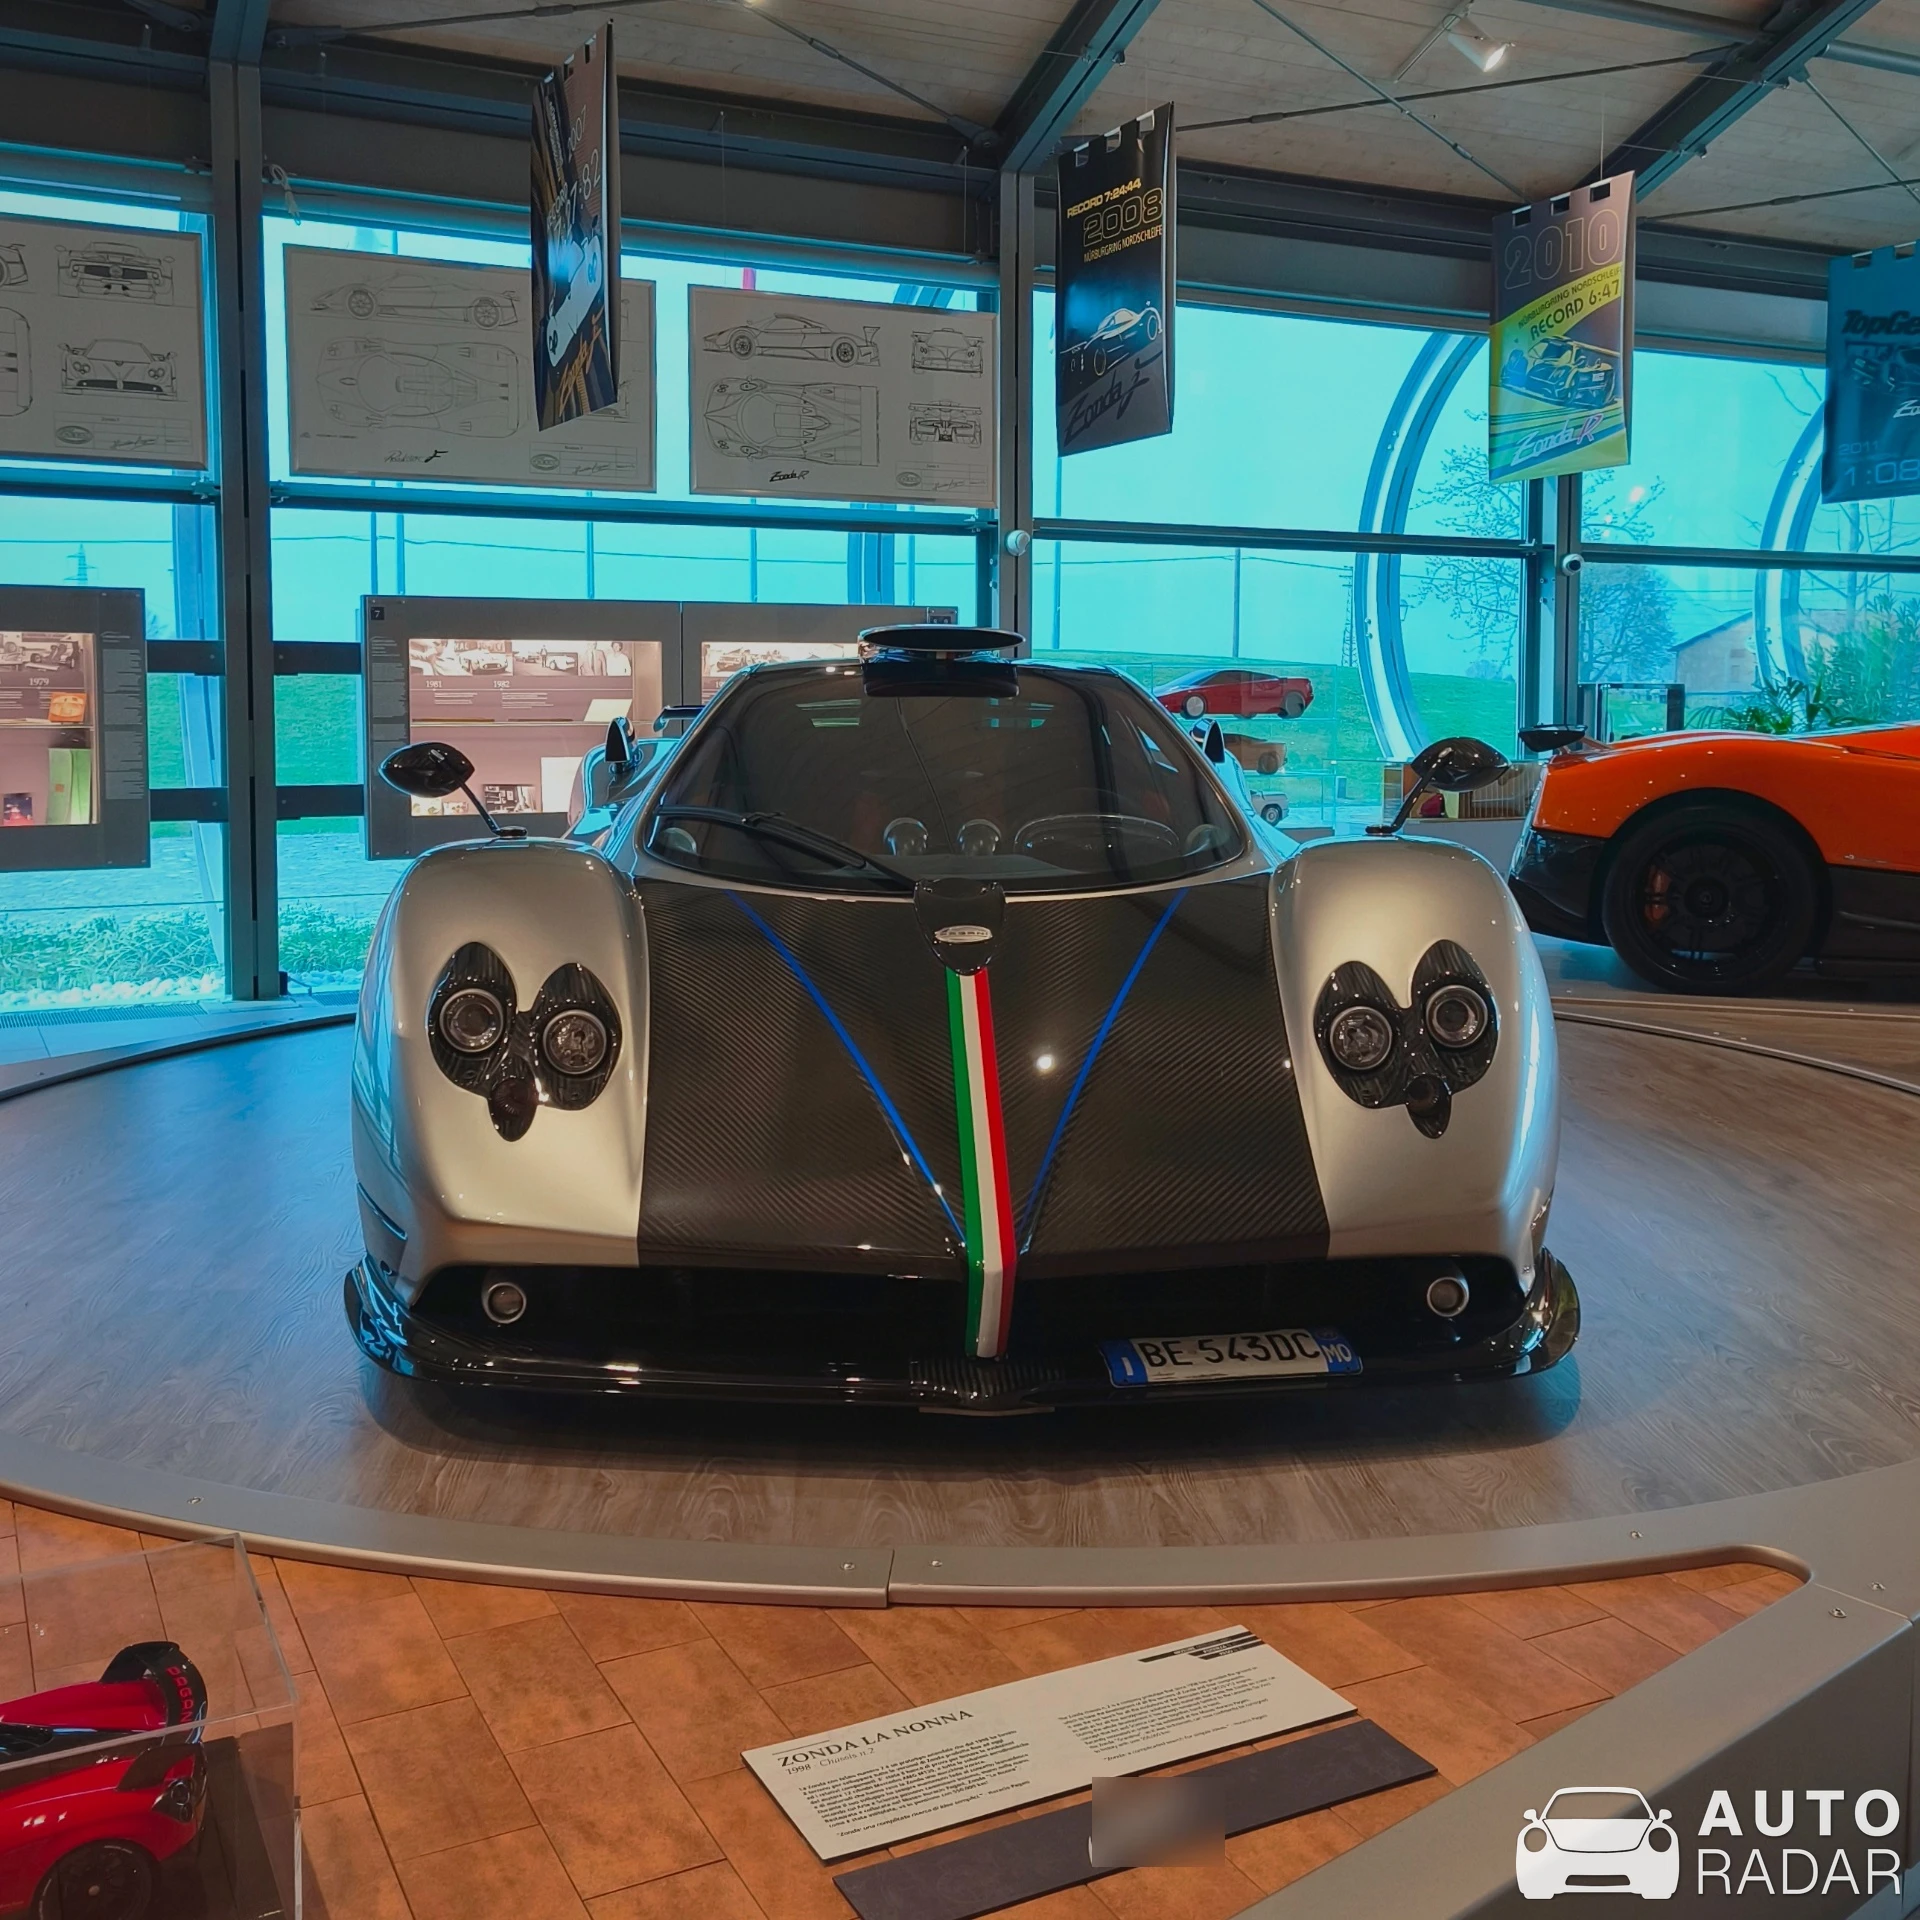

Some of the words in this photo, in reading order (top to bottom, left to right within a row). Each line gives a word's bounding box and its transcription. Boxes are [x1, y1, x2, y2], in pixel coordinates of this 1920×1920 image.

[567, 104, 587, 163] 2007
[1066, 195, 1103, 219] RECORD
[1104, 177, 1142, 202] 7:24:44
[1083, 187, 1164, 247] 2008
[1122, 224, 1163, 248] NORDSCHLEIFE
[1504, 208, 1621, 290] 2010
[1571, 265, 1622, 294] NORDSCHLEIF
[1529, 297, 1584, 341] RECORD
[1588, 279, 1621, 306] 6:47
[1841, 309, 1920, 339] TopGe
[1064, 369, 1122, 448] Zonda
[1510, 418, 1579, 467] Zonda
[1576, 413, 1604, 445] R
[1844, 459, 1920, 486] 1:08
[29, 677, 50, 686] 1979
[1137, 1341, 1193, 1368] BE
[1198, 1332, 1320, 1364] 543DC
[1320, 1343, 1352, 1364] MO
[777, 1740, 859, 1767] ZONDA
[861, 1732, 890, 1745] LA
[892, 1710, 973, 1737] NONNA
[785, 1763, 811, 1774] 1998
[819, 1753, 857, 1766] Chassis
